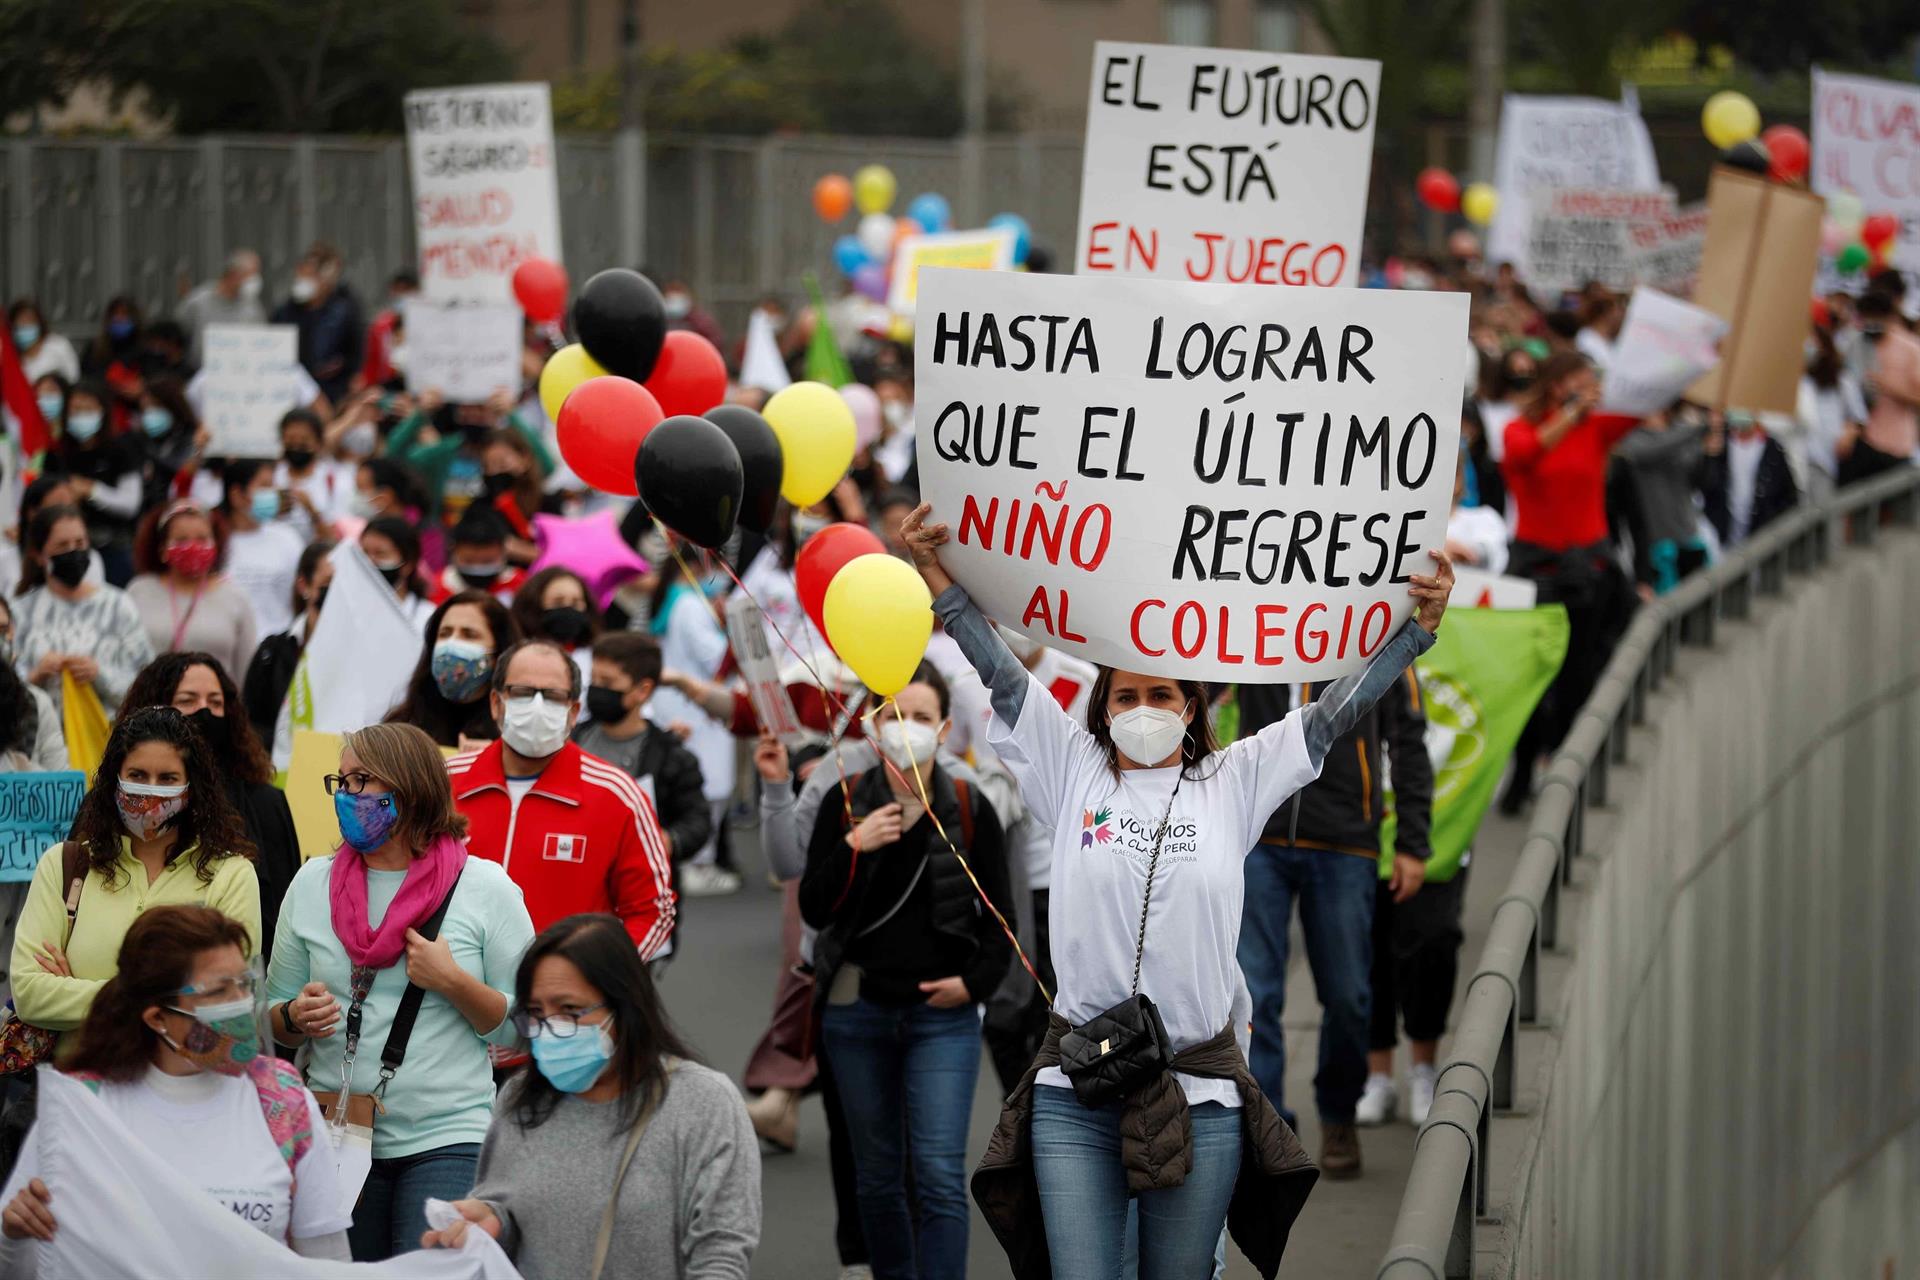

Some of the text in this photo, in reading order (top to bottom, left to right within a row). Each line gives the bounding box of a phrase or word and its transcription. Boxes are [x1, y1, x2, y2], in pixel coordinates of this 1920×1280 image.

[1103, 55, 1370, 132] EL FUTURO
[1147, 142, 1279, 202] ESTÁ
[1087, 221, 1347, 287] EN JUEGO
[933, 311, 1376, 384] HASTA LOGRAR
[933, 392, 1438, 491] QUE EL ÚLTIMO
[958, 480, 1428, 586] NIÑO REGRESE
[1022, 585, 1393, 667] AL COLEGIO
[1114, 835, 1124, 846] A
[1164, 839, 1196, 855] PERÚ
[1119, 817, 1197, 842] VOLVMOS
